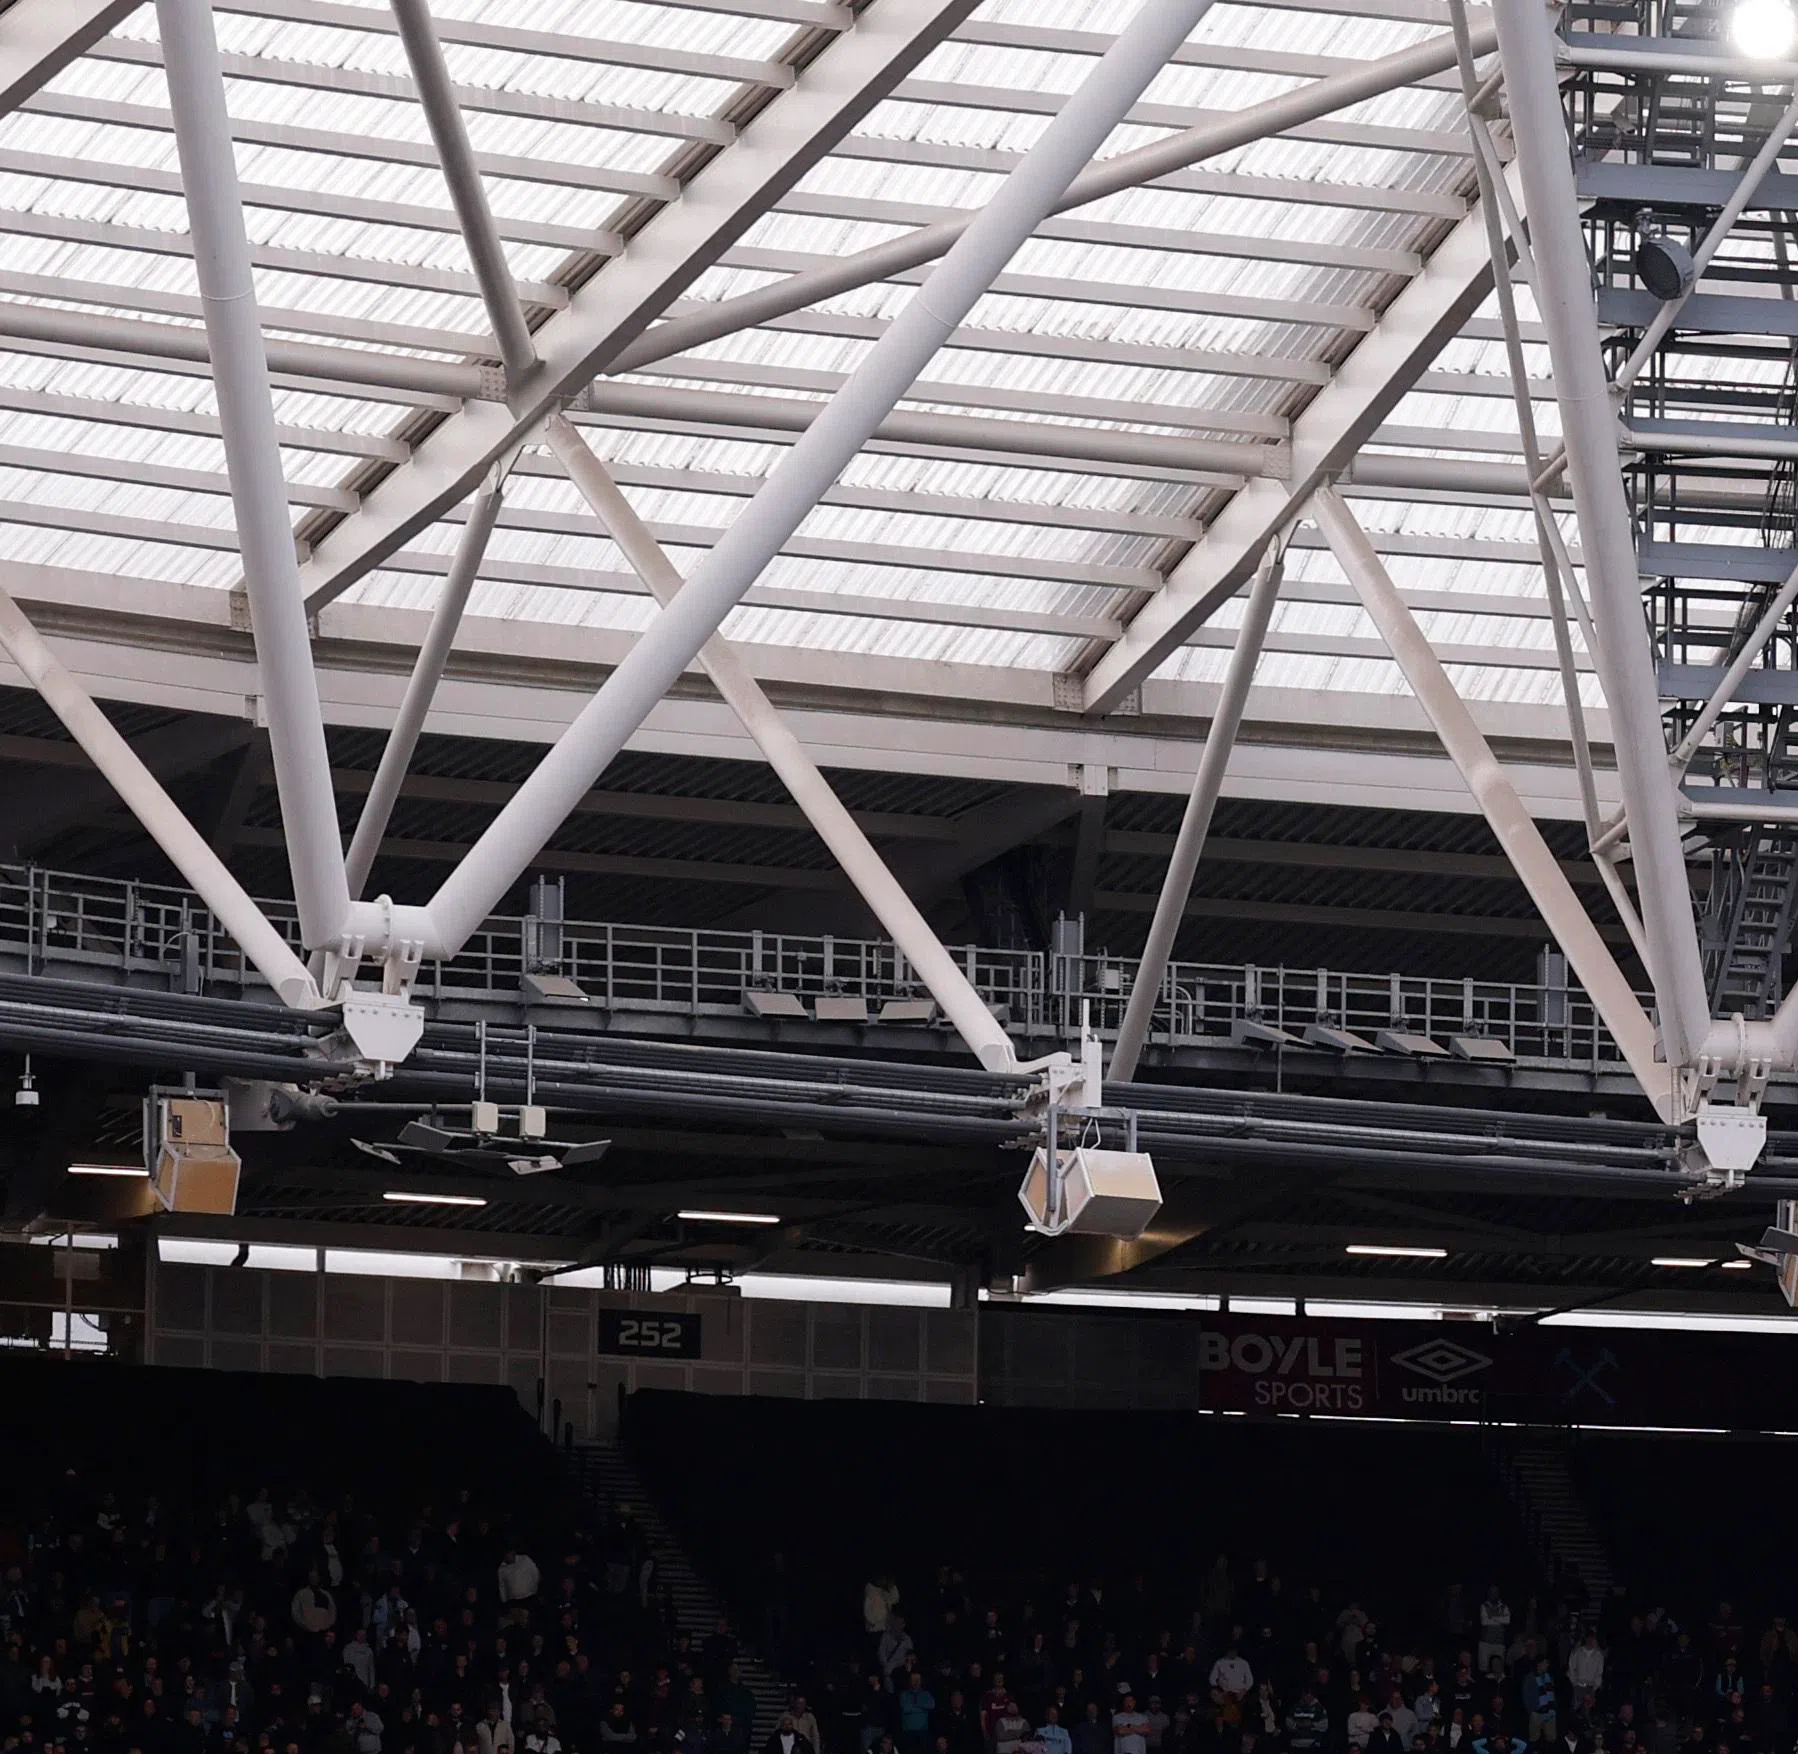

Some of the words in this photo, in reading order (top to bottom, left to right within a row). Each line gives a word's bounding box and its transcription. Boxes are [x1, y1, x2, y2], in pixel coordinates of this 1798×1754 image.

[619, 1320, 681, 1347] 252
[1200, 1331, 1362, 1378] BOYLE
[1254, 1381, 1364, 1409] SPORTS
